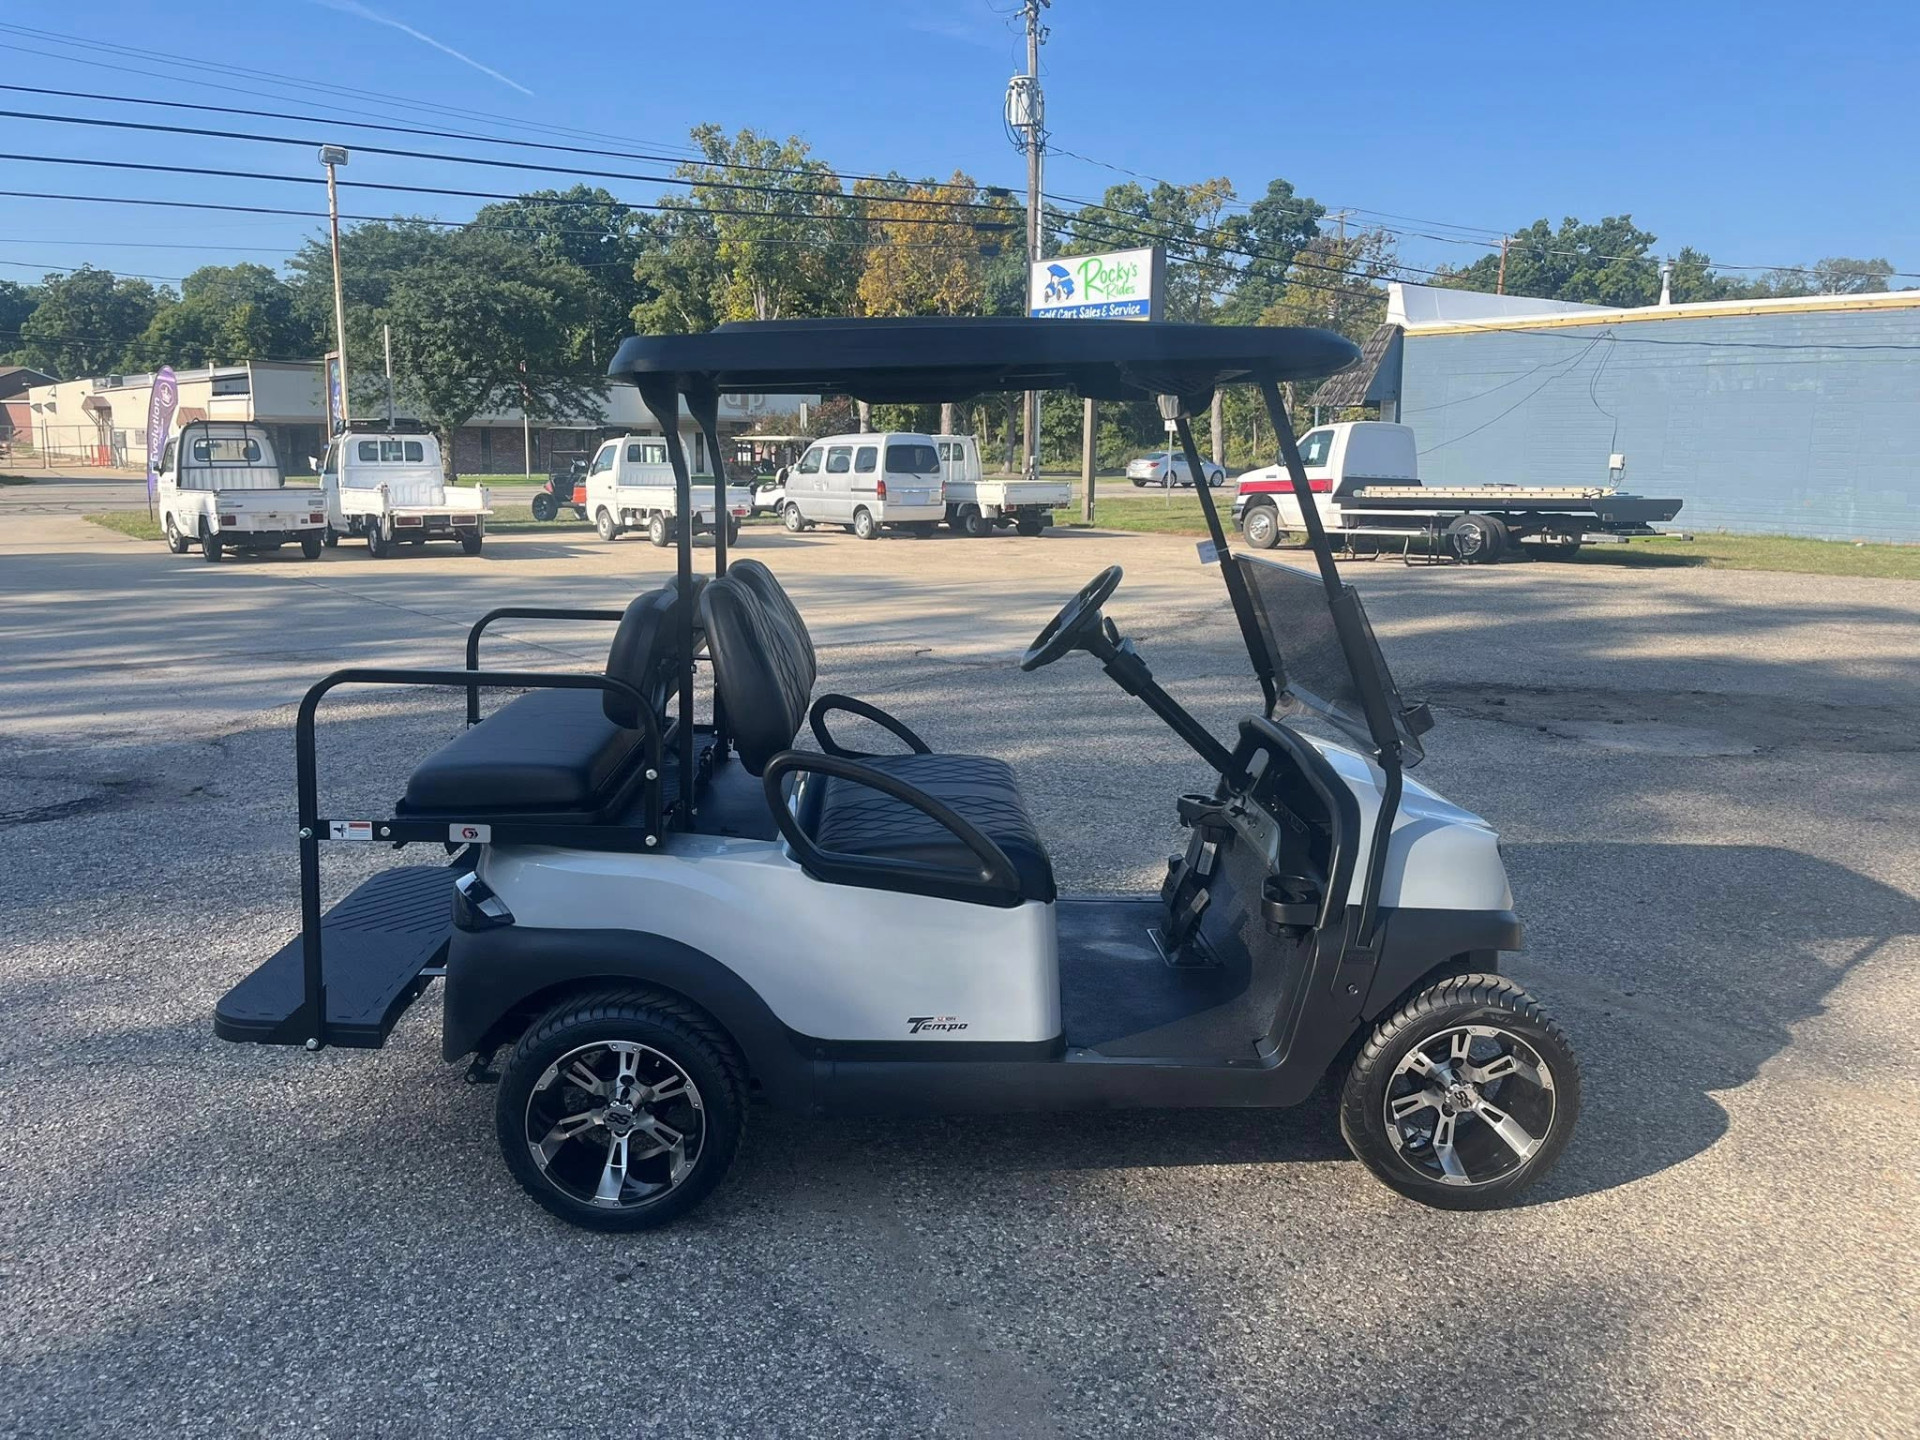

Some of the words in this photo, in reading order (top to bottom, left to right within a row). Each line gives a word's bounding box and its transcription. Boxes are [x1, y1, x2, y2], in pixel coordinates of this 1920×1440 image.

[1077, 258, 1138, 300] Rocky's
[1104, 283, 1136, 300] Rides
[1038, 309, 1057, 319] Golf
[1058, 309, 1078, 318] Cart
[1079, 306, 1101, 318] Sales
[1109, 303, 1140, 316] Service
[151, 397, 160, 462] Evolution
[907, 1017, 969, 1034] Tempo
